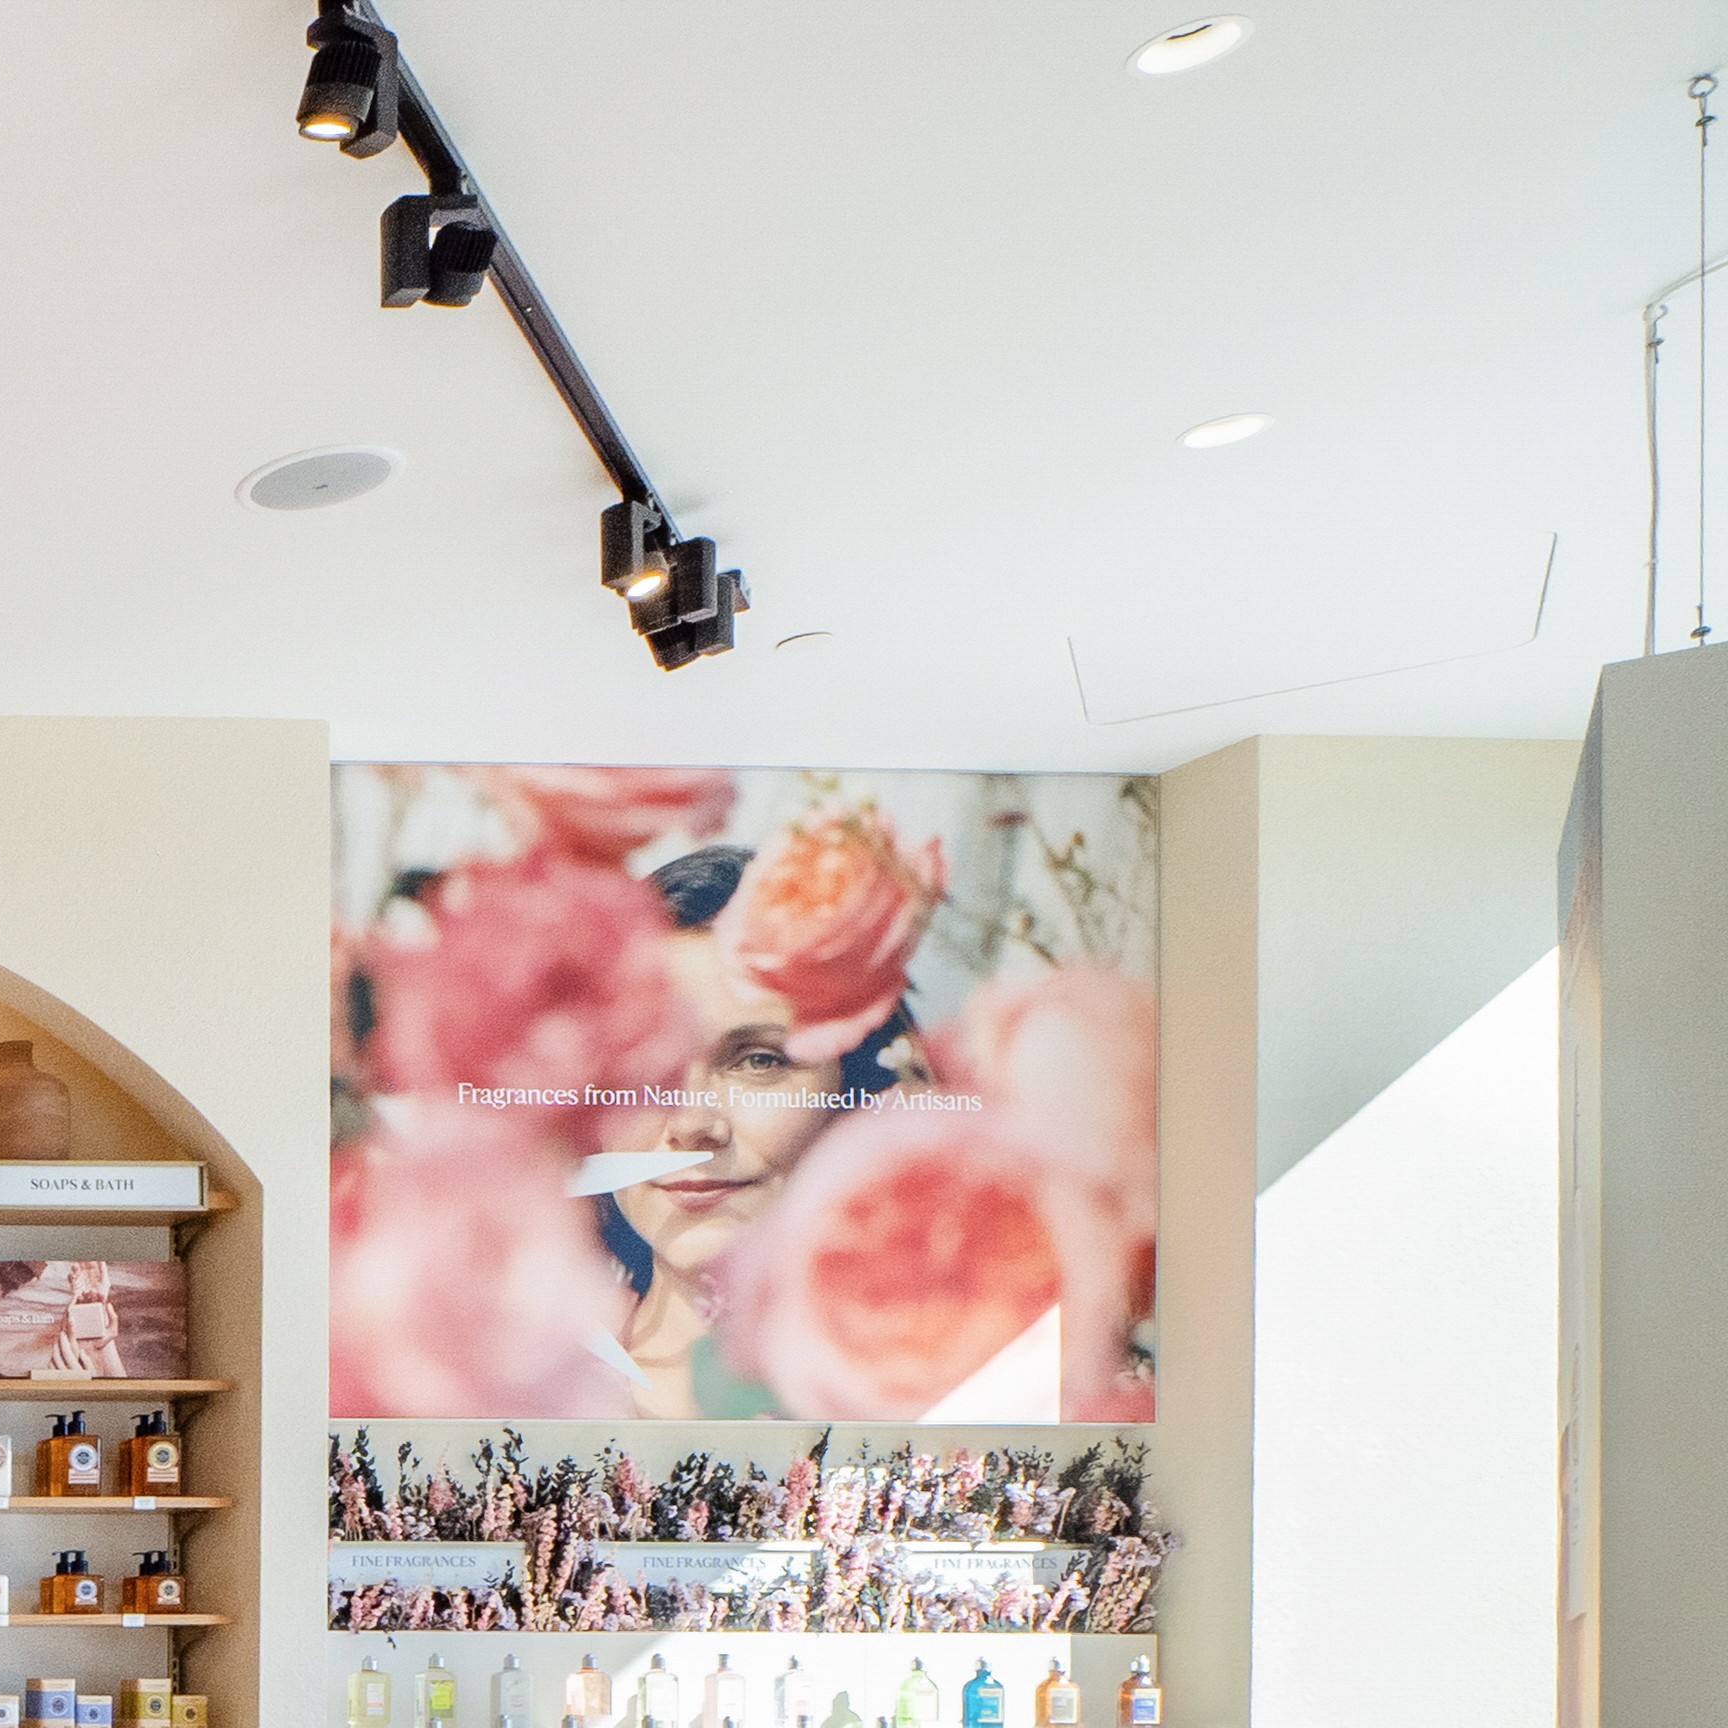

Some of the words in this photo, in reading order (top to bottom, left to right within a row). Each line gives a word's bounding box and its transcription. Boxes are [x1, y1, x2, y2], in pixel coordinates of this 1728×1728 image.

[458, 1083, 578, 1110] Fragrances
[584, 1084, 637, 1105] from
[643, 1086, 723, 1111] Nature,
[729, 1087, 854, 1110] Formulated
[858, 1088, 886, 1115] by
[893, 1090, 982, 1112] Artisans
[30, 1178, 78, 1191] SOAPS
[81, 1178, 92, 1191] &
[95, 1179, 135, 1191] BATH
[21, 1314, 31, 1325] &
[32, 1313, 55, 1325] Bath
[352, 1555, 383, 1567] FINE
[385, 1555, 477, 1568] FRAGRANCES
[643, 1556, 674, 1568] FINE
[677, 1556, 767, 1569] FRAGRANCES
[967, 1557, 1058, 1570] FRAGRANCES
